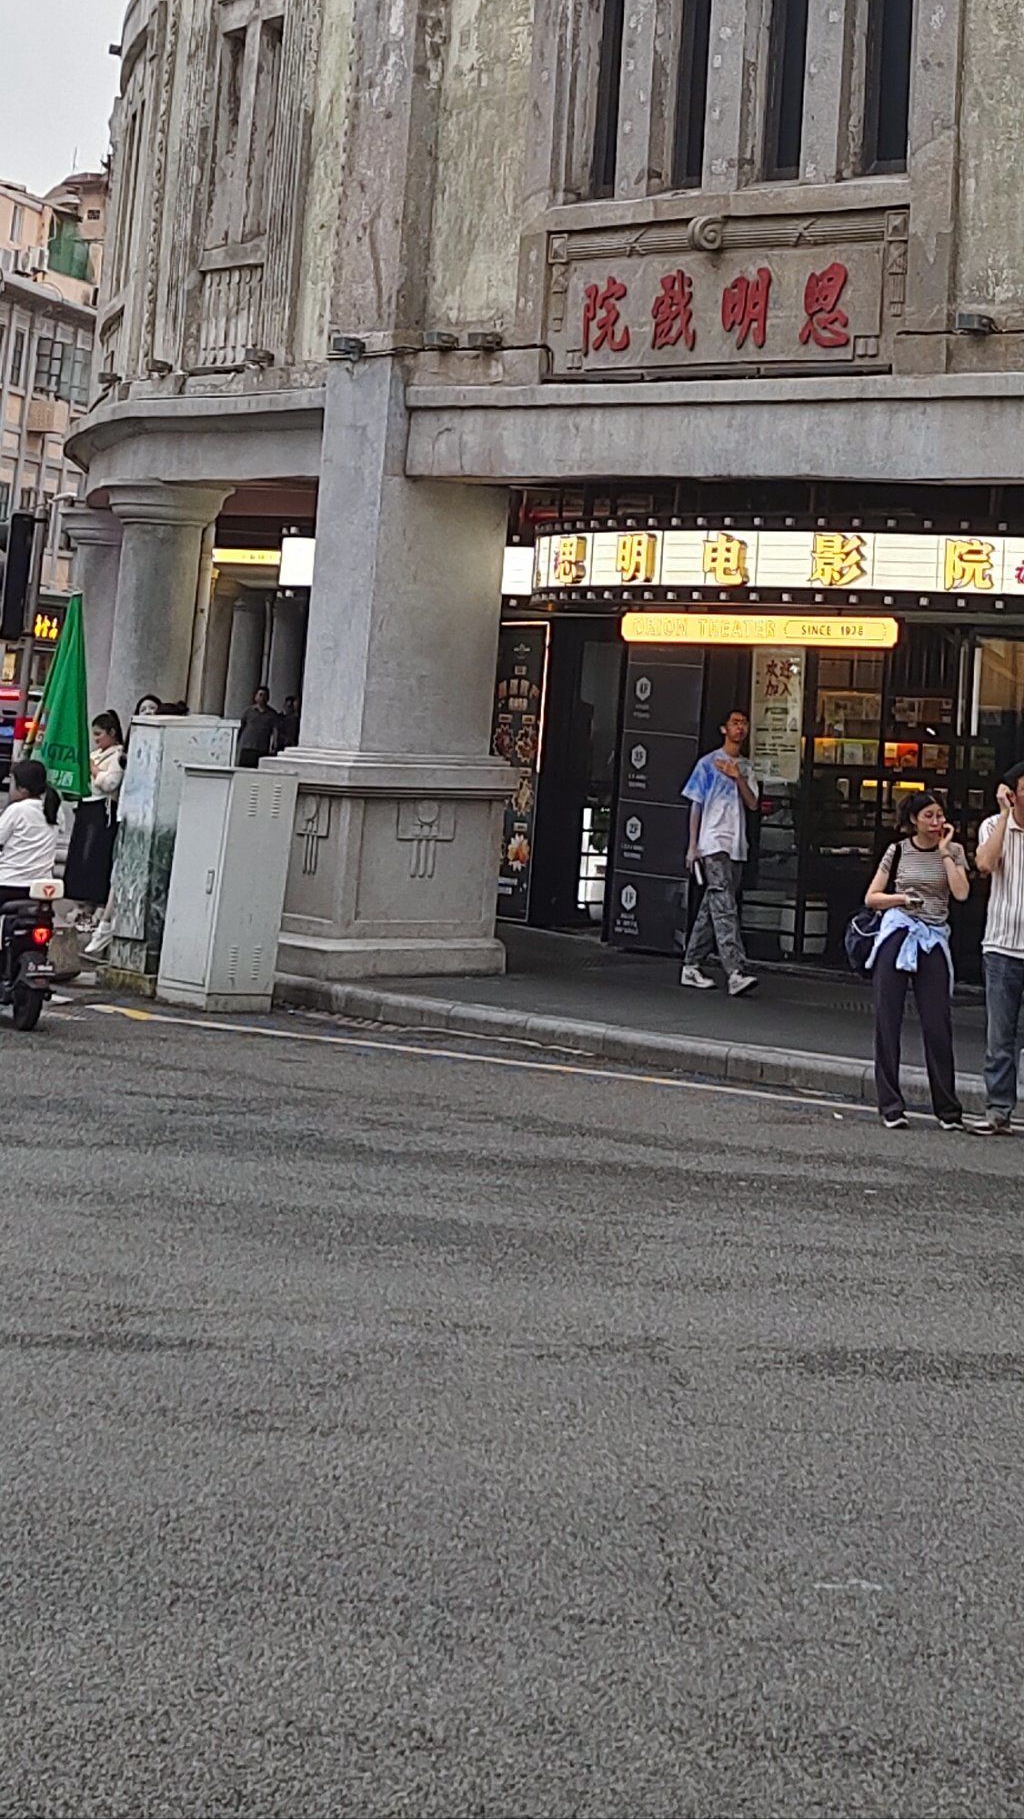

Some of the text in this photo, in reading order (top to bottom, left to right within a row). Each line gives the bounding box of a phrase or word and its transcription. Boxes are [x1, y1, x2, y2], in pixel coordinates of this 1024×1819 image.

[554, 532, 996, 592] 思明电影院
[697, 618, 777, 639] THEATER
[801, 624, 832, 636] SINCE
